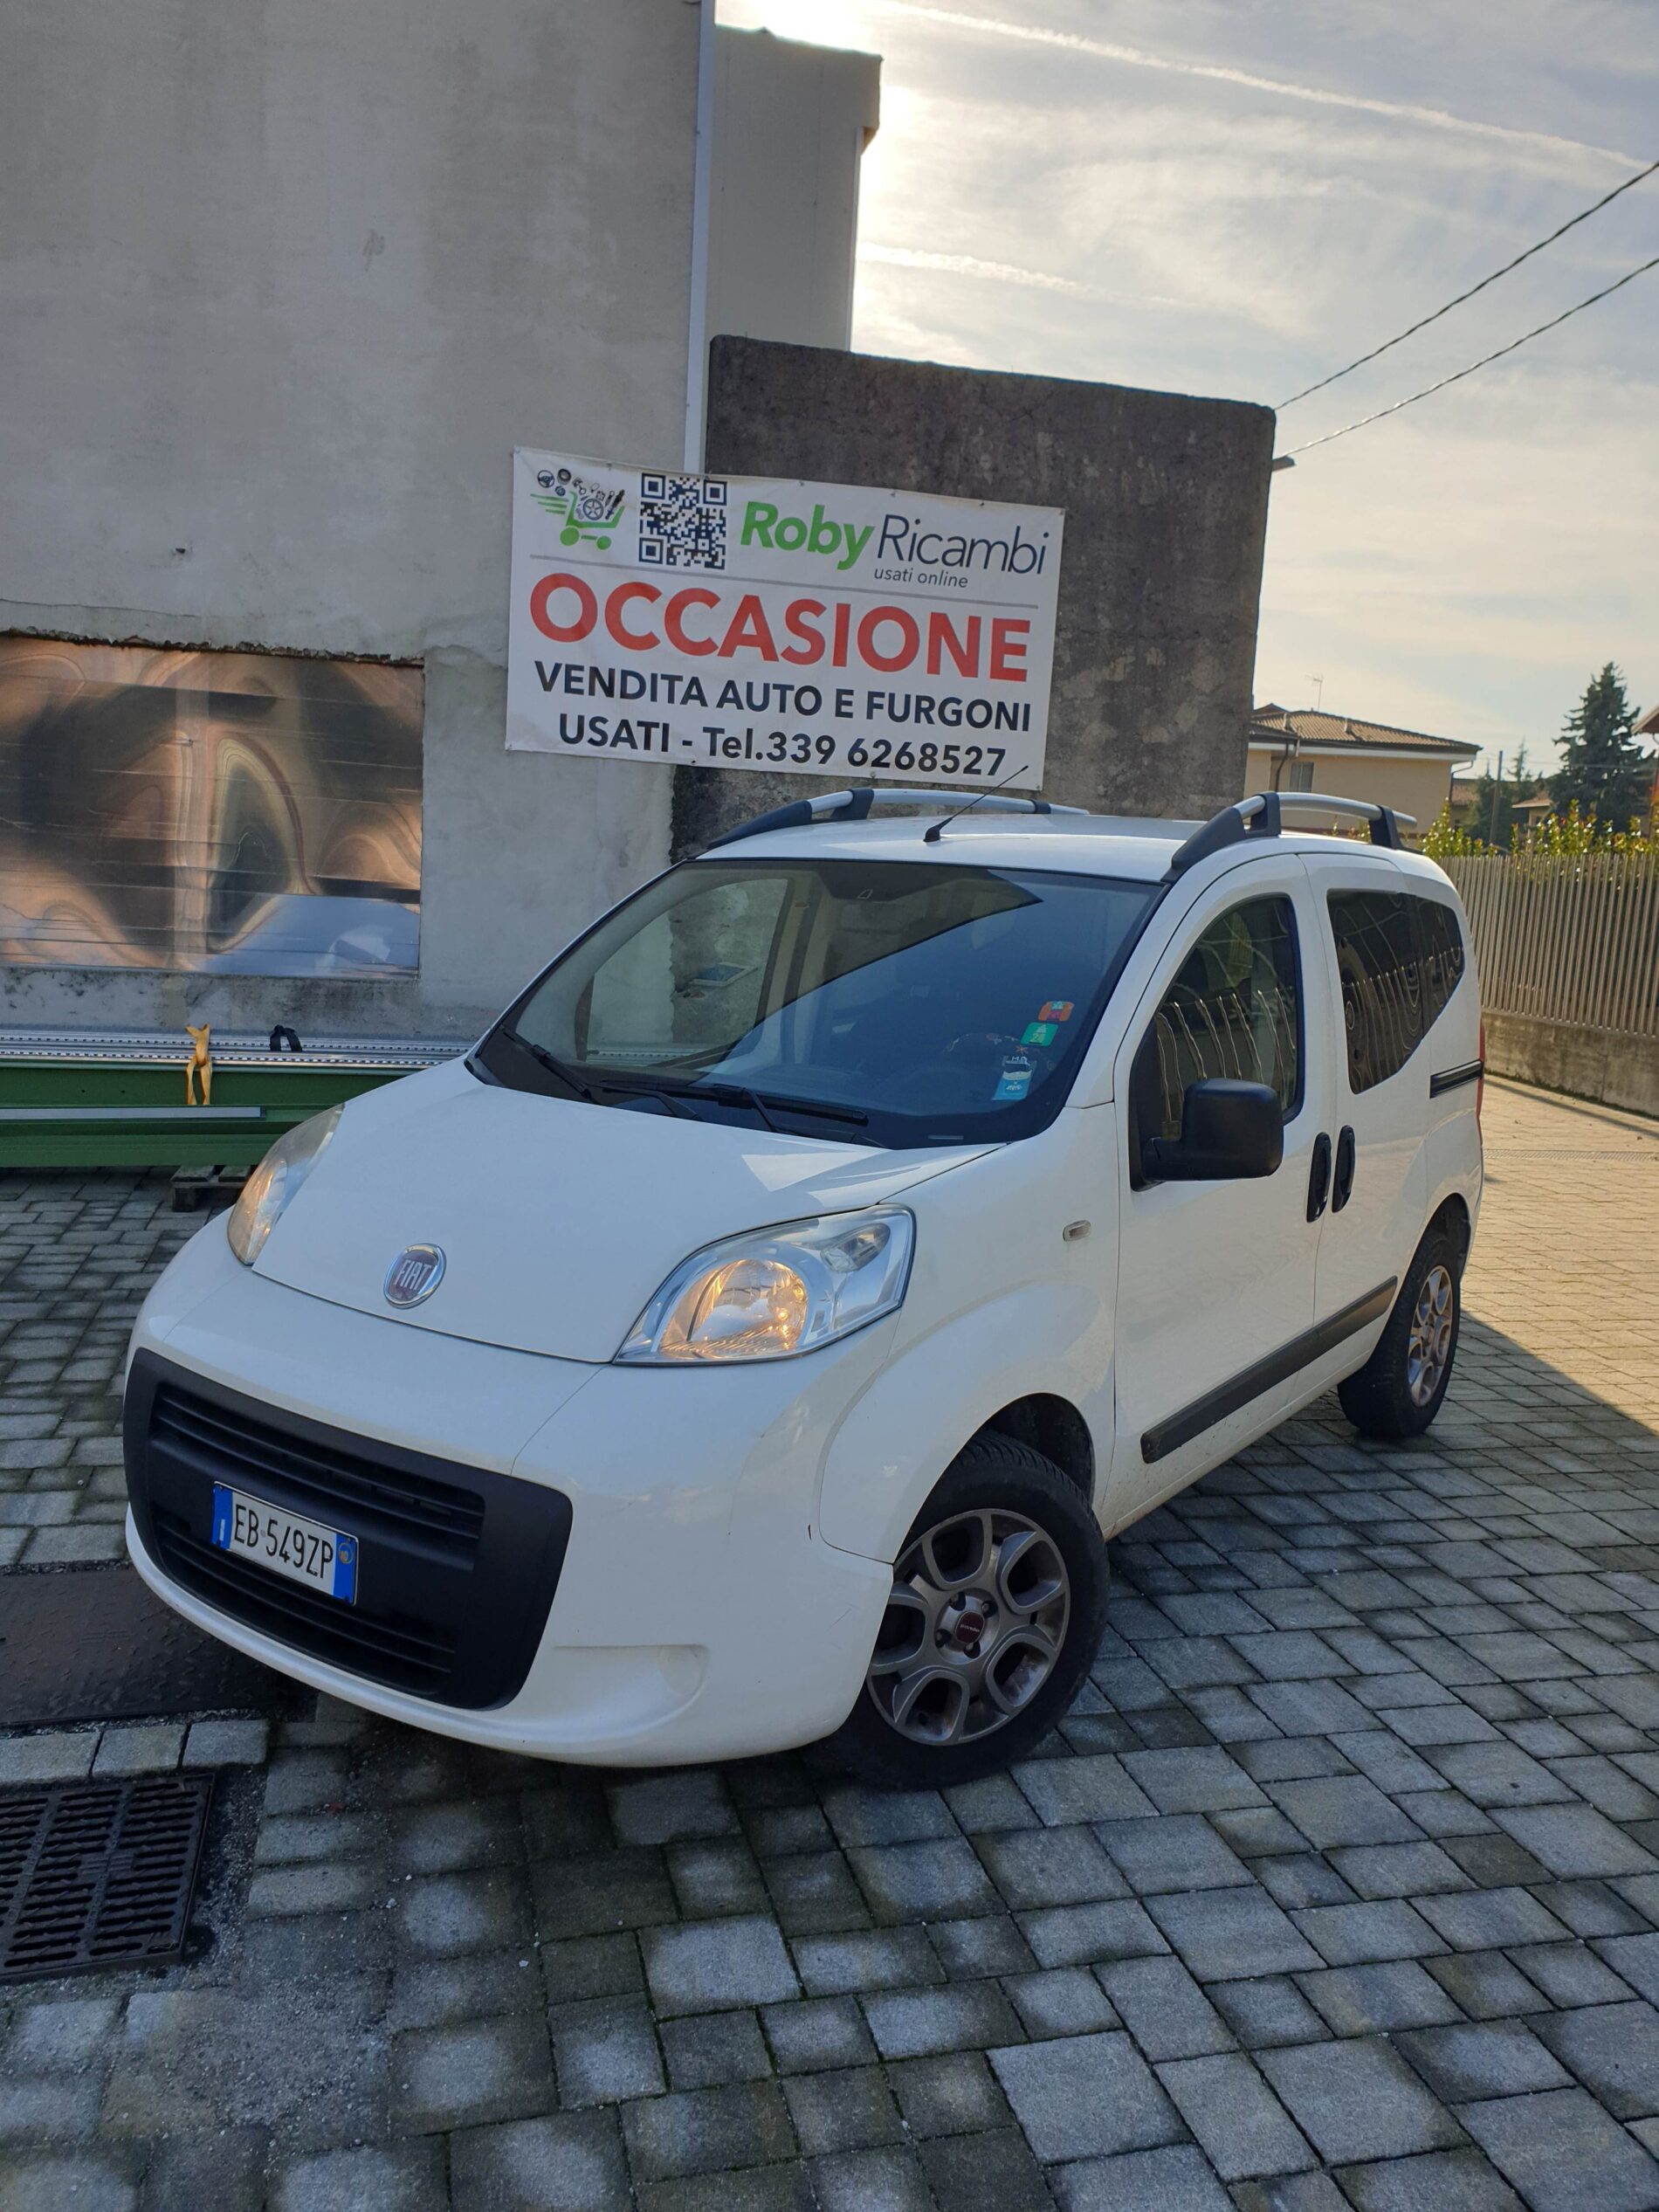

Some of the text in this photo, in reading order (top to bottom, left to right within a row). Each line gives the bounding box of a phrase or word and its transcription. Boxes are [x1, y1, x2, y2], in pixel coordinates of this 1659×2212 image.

[740, 500, 1050, 575] Roby Ricambi
[874, 567, 968, 589] usati online
[529, 573, 1031, 683] OCCASIONE
[534, 661, 1031, 732] VENDITA AUTO E FURGONI
[560, 713, 670, 753] USATI
[702, 726, 836, 765] Tel.339
[848, 737, 1006, 776] 6268527
[394, 1259, 432, 1291] FIAT
